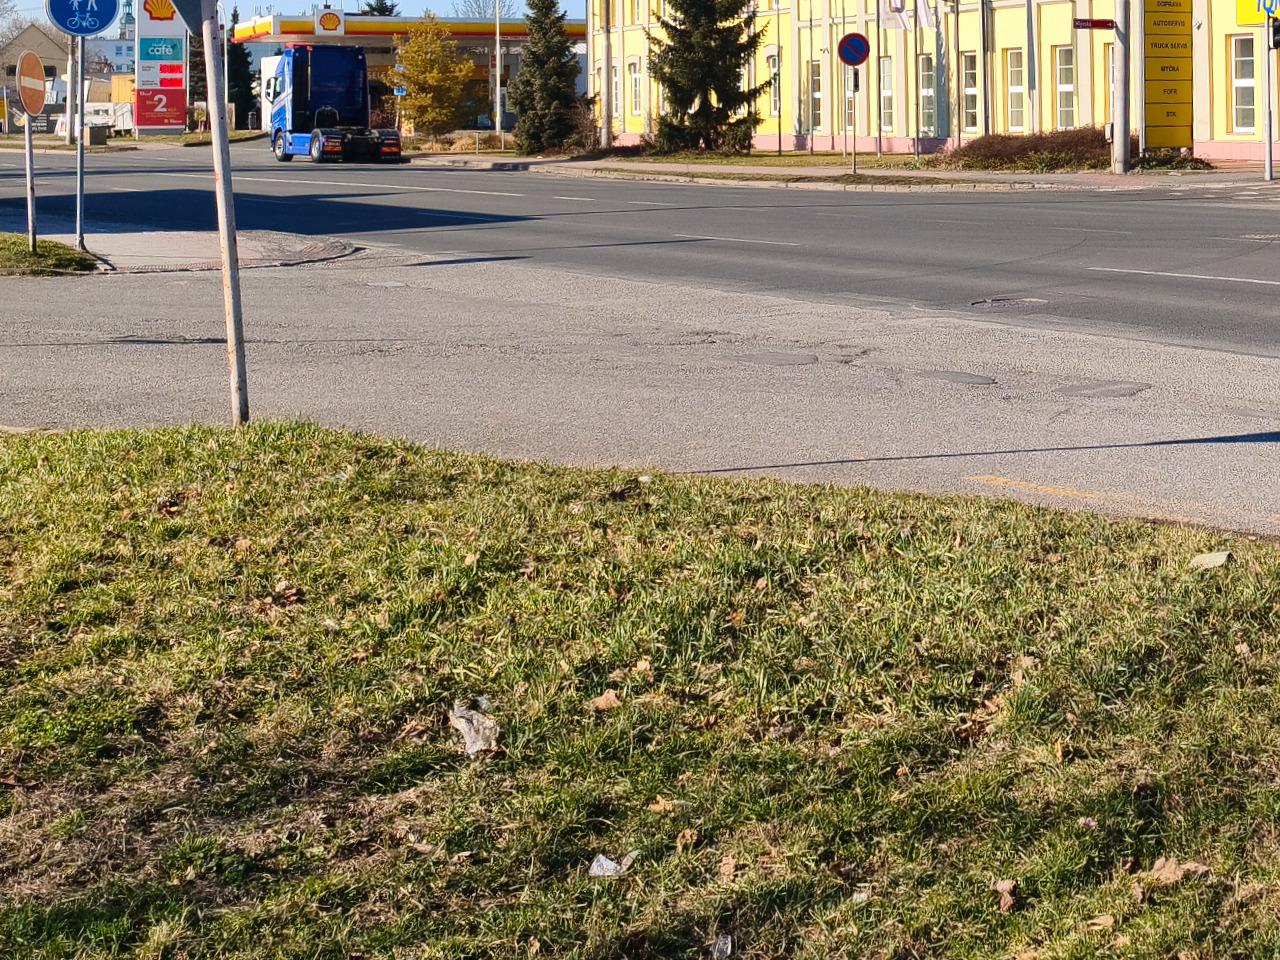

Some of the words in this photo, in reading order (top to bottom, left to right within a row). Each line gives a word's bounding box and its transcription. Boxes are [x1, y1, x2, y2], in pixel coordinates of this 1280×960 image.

[1153, 19, 1185, 28] AUTOSERVIS
[1170, 42, 1188, 50] SERVIS
[154, 94, 167, 112] 2
